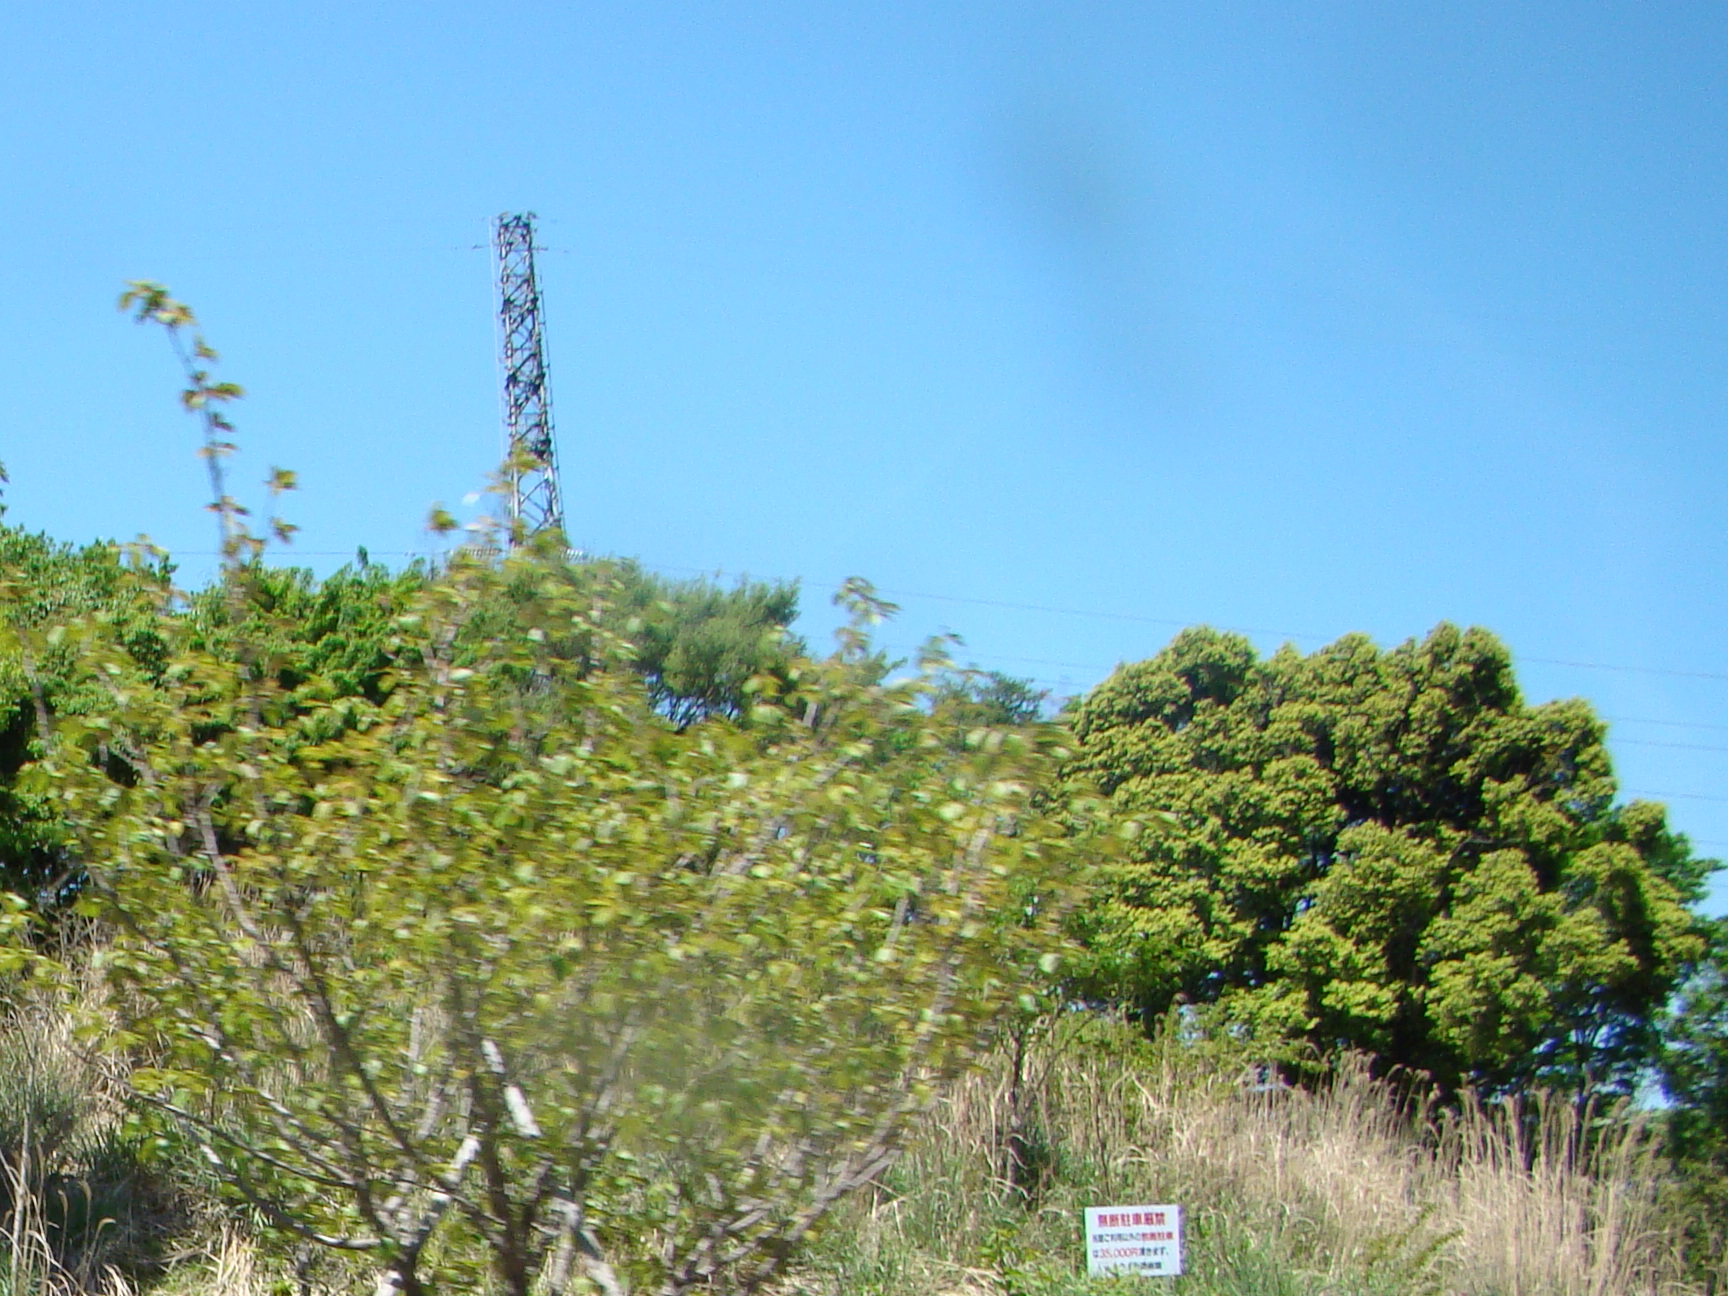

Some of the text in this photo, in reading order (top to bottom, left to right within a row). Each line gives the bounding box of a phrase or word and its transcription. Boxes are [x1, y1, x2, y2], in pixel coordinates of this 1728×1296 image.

[1098, 1212, 1165, 1227] 無断駐車厳禁
